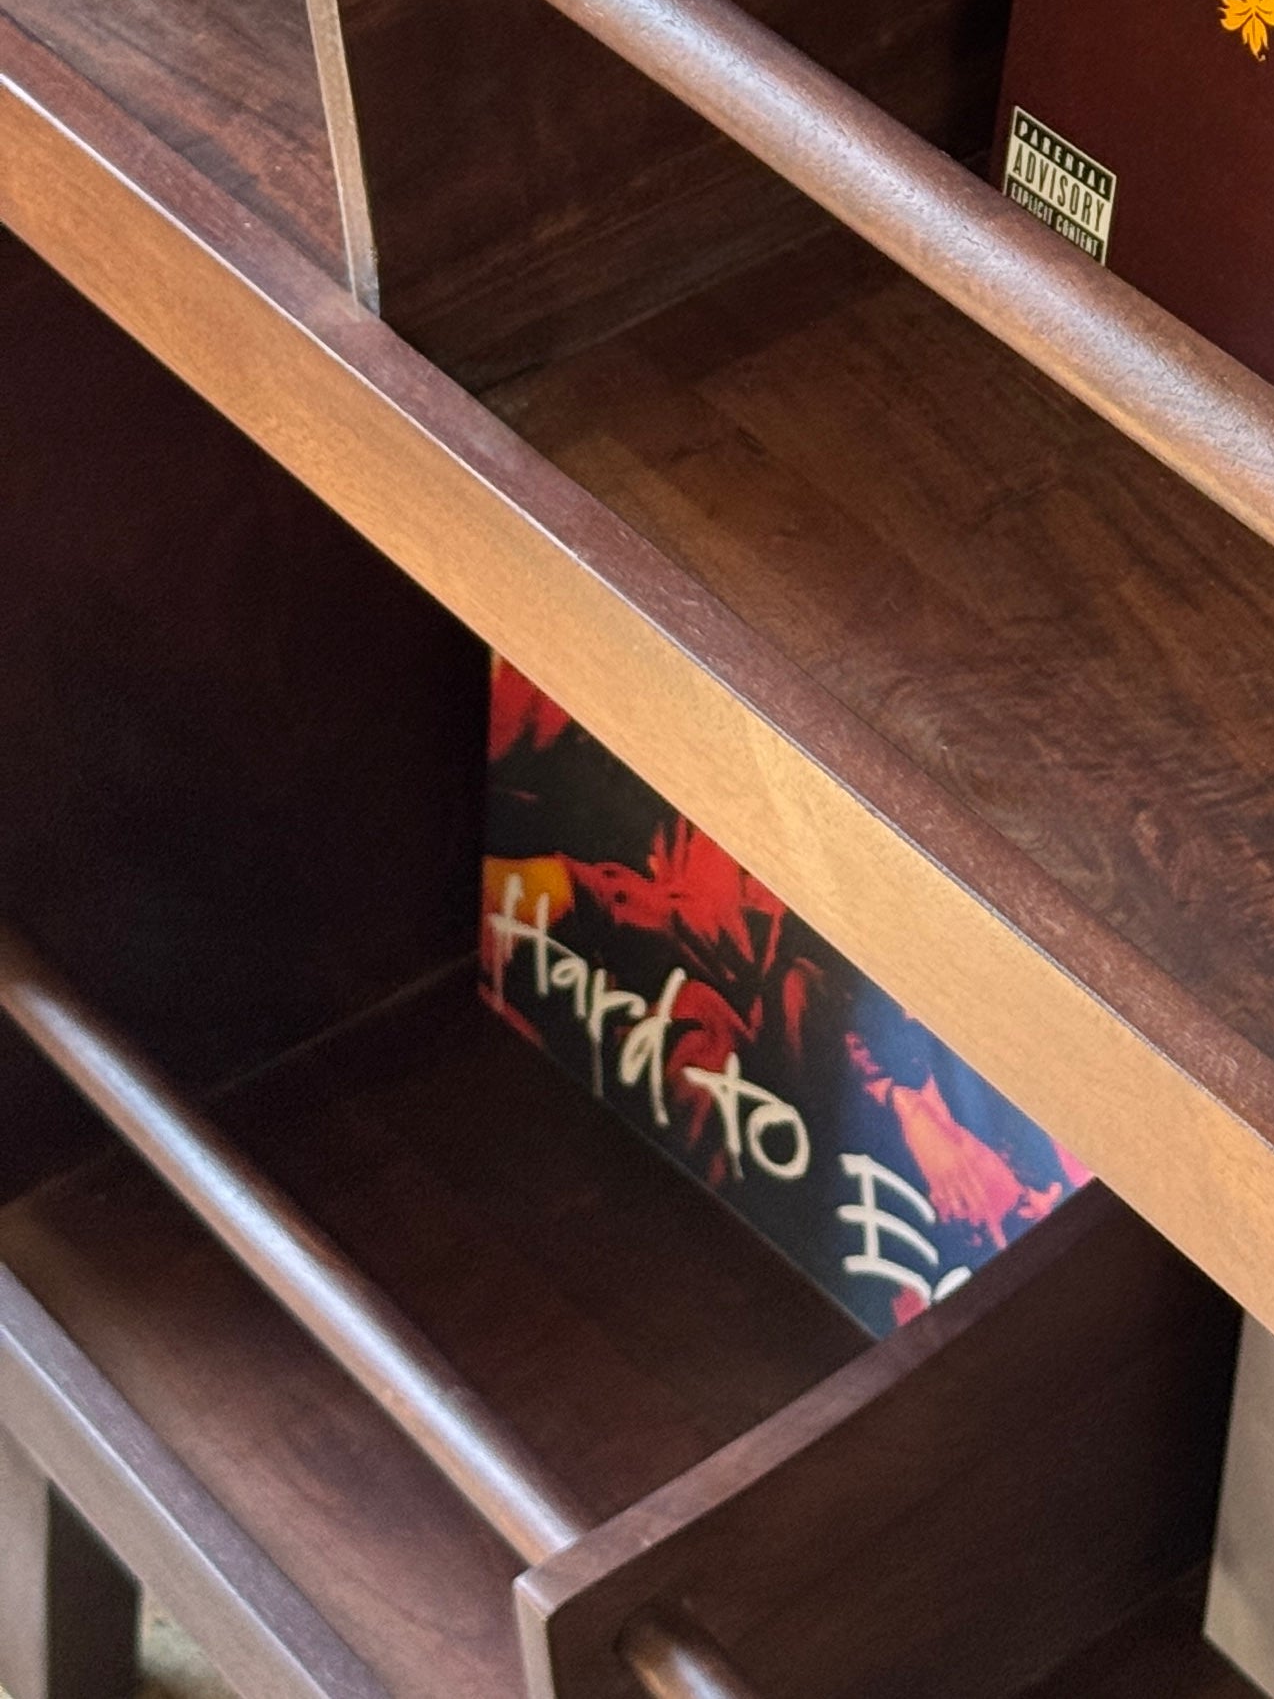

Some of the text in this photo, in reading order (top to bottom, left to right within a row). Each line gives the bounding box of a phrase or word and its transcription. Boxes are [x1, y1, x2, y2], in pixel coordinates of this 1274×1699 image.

[1012, 143, 1105, 232] ADVISORY
[1018, 119, 1107, 195] PARENTAL
[1010, 182, 1099, 257] EXPLICIT CONTENT
[488, 873, 972, 1307] Hard to E
